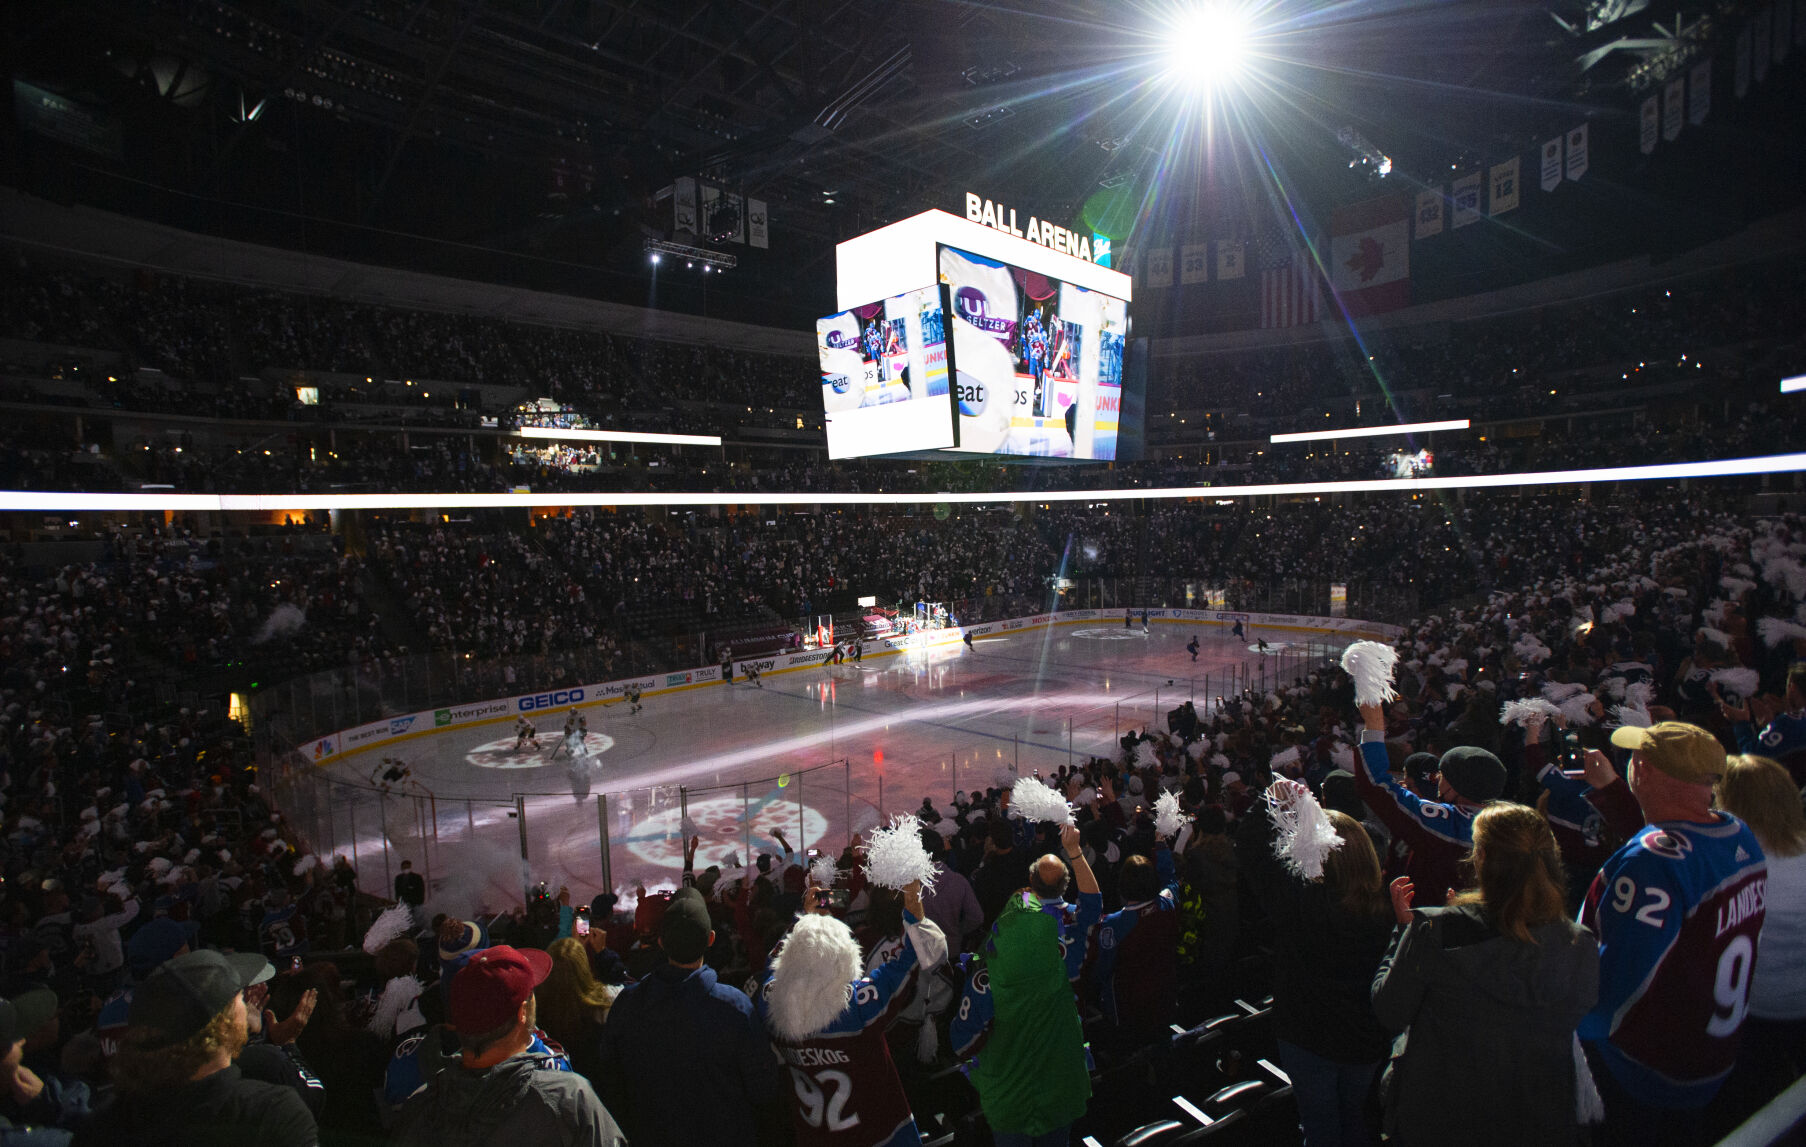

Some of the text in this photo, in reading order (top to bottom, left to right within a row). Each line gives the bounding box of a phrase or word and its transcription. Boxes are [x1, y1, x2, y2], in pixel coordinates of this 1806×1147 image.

[966, 192, 1092, 262] BALL ARENA
[832, 376, 848, 388] eat
[956, 384, 984, 403] eat
[884, 640, 903, 648] Great
[695, 668, 716, 677] TRULY
[518, 689, 584, 711] GEICO
[1611, 875, 1670, 928] 92
[1706, 935, 1752, 1038] 9
[960, 996, 971, 1021] 8
[790, 1064, 860, 1131] 92
